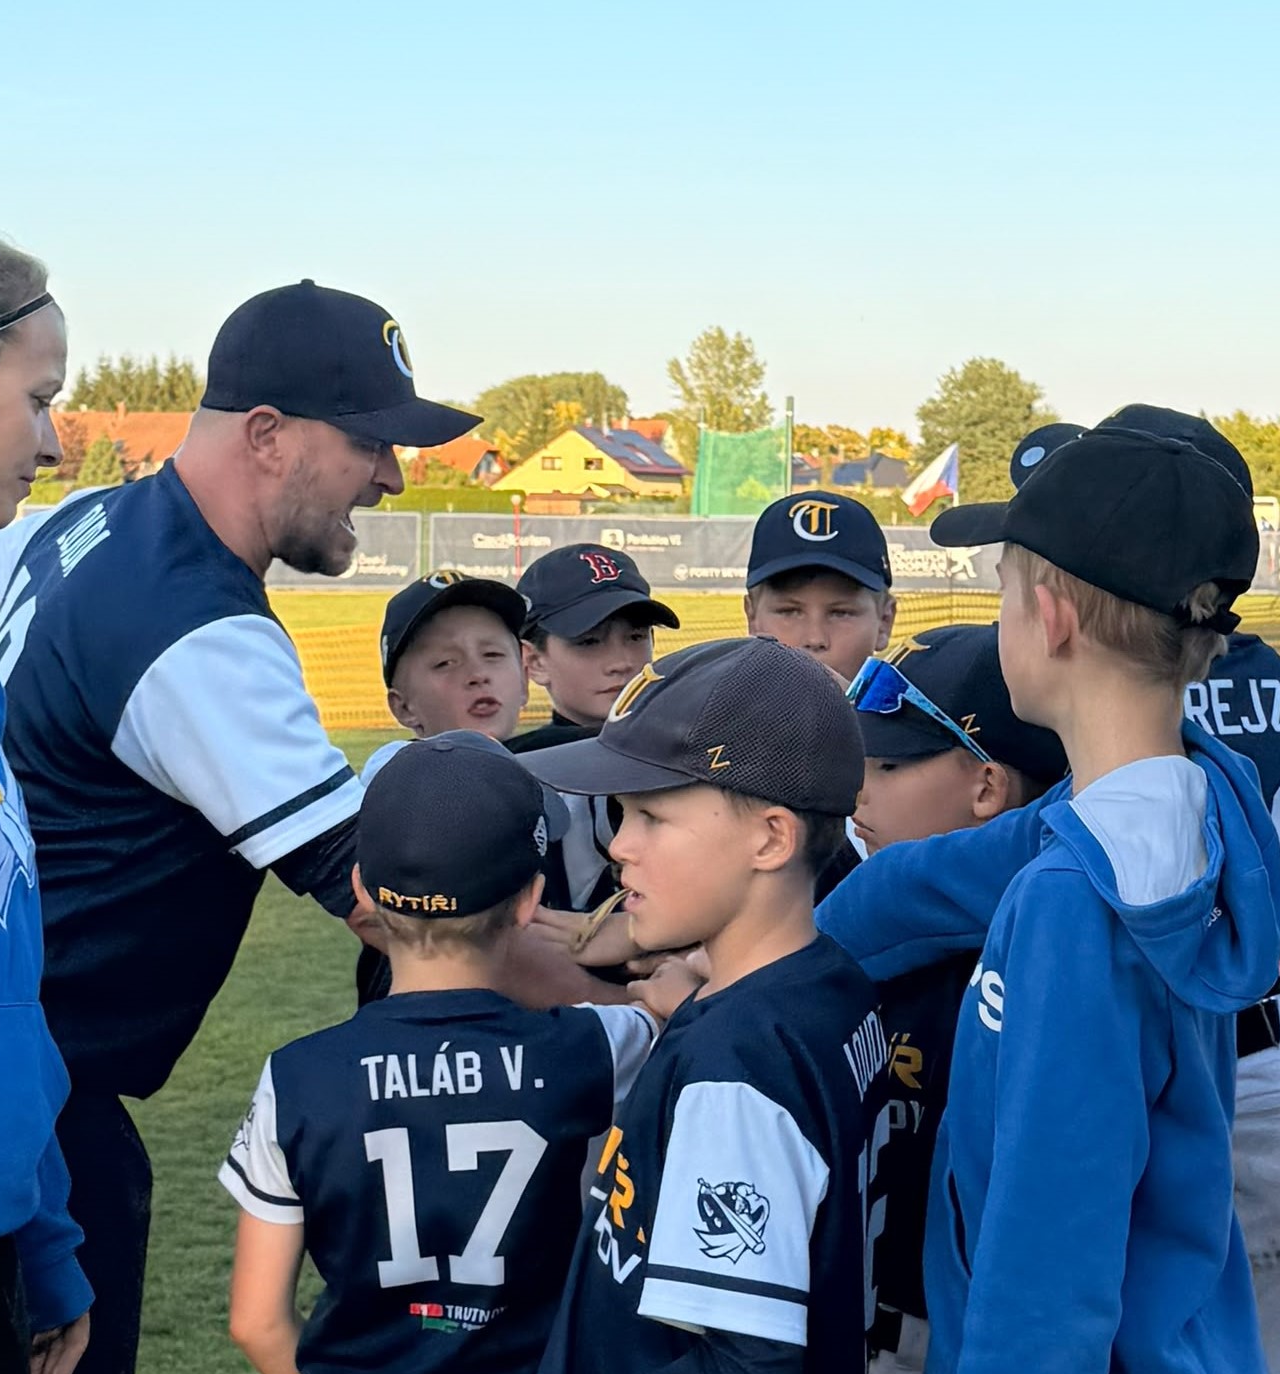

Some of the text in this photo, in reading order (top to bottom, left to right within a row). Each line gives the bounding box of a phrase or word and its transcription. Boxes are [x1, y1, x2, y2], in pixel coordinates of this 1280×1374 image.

[581, 551, 623, 585] B
[378, 886, 458, 912] RYTÍŘI
[360, 1041, 545, 1101] TALÁB V.
[363, 1119, 549, 1289] 17
